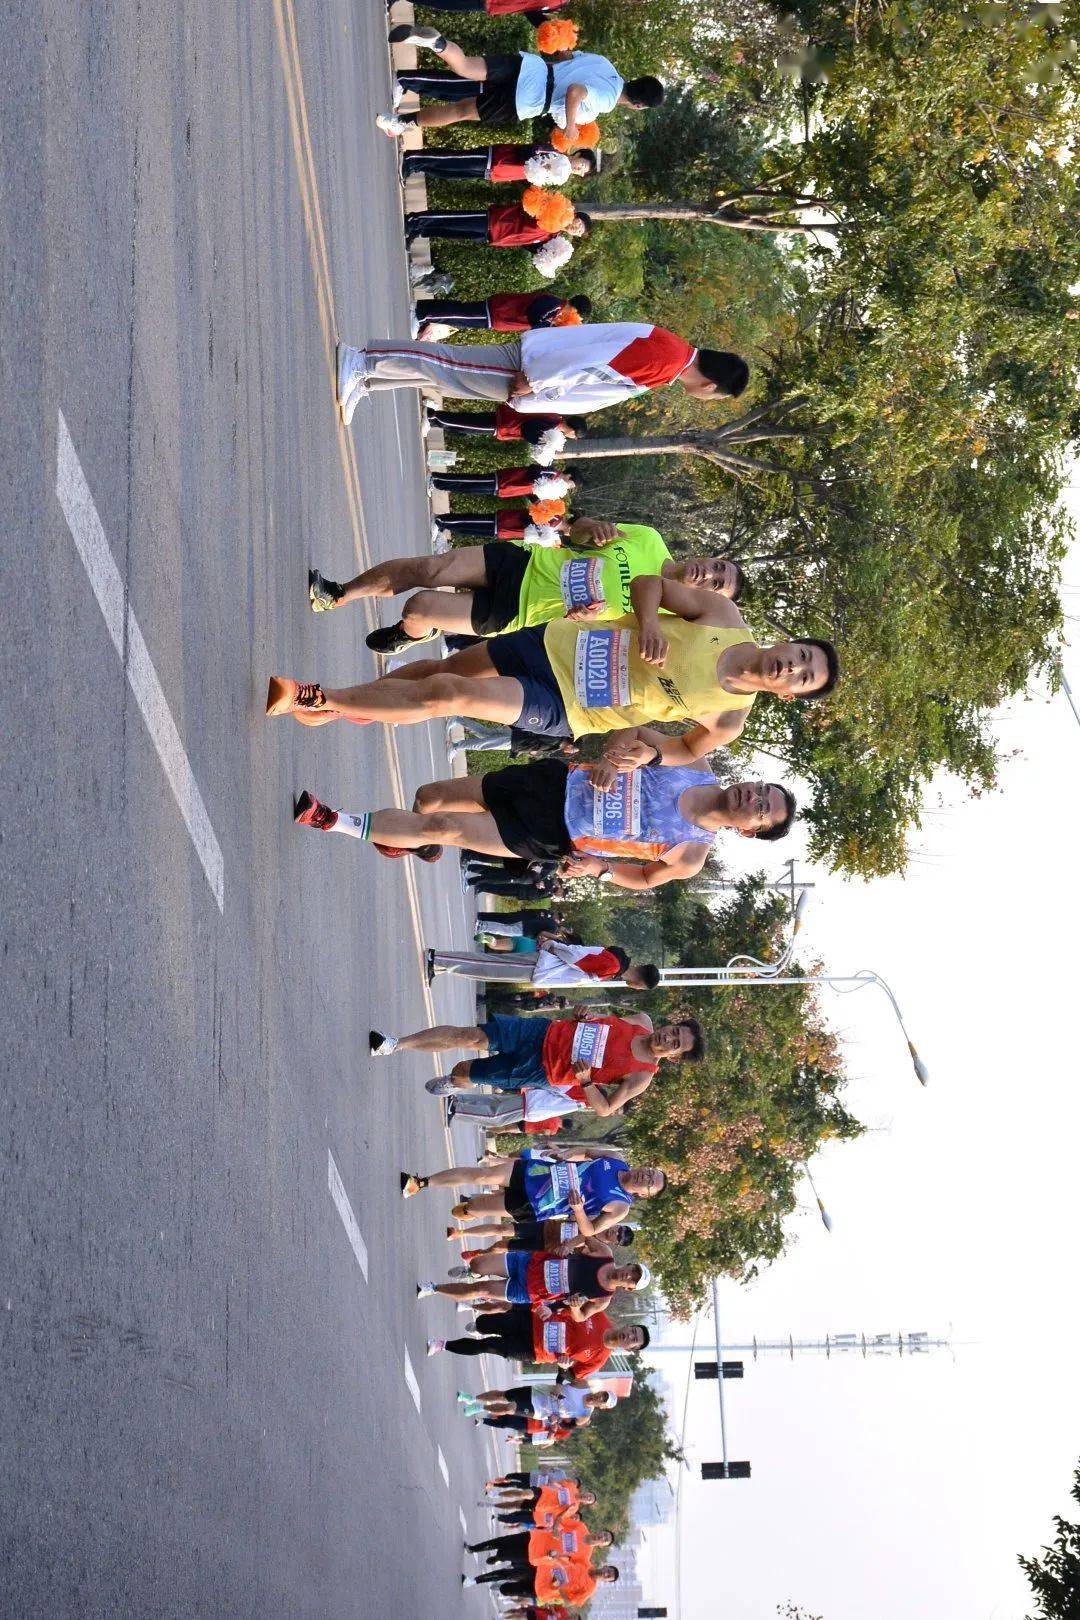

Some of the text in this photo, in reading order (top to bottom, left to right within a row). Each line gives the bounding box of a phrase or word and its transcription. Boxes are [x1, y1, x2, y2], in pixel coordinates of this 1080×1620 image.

[571, 562, 588, 601] A0108
[614, 546, 630, 591] FOTILE
[588, 636, 609, 690] A0020
[580, 1026, 596, 1056] A0050
[556, 1166, 569, 1190] A0127
[550, 1262, 560, 1286] A0122
